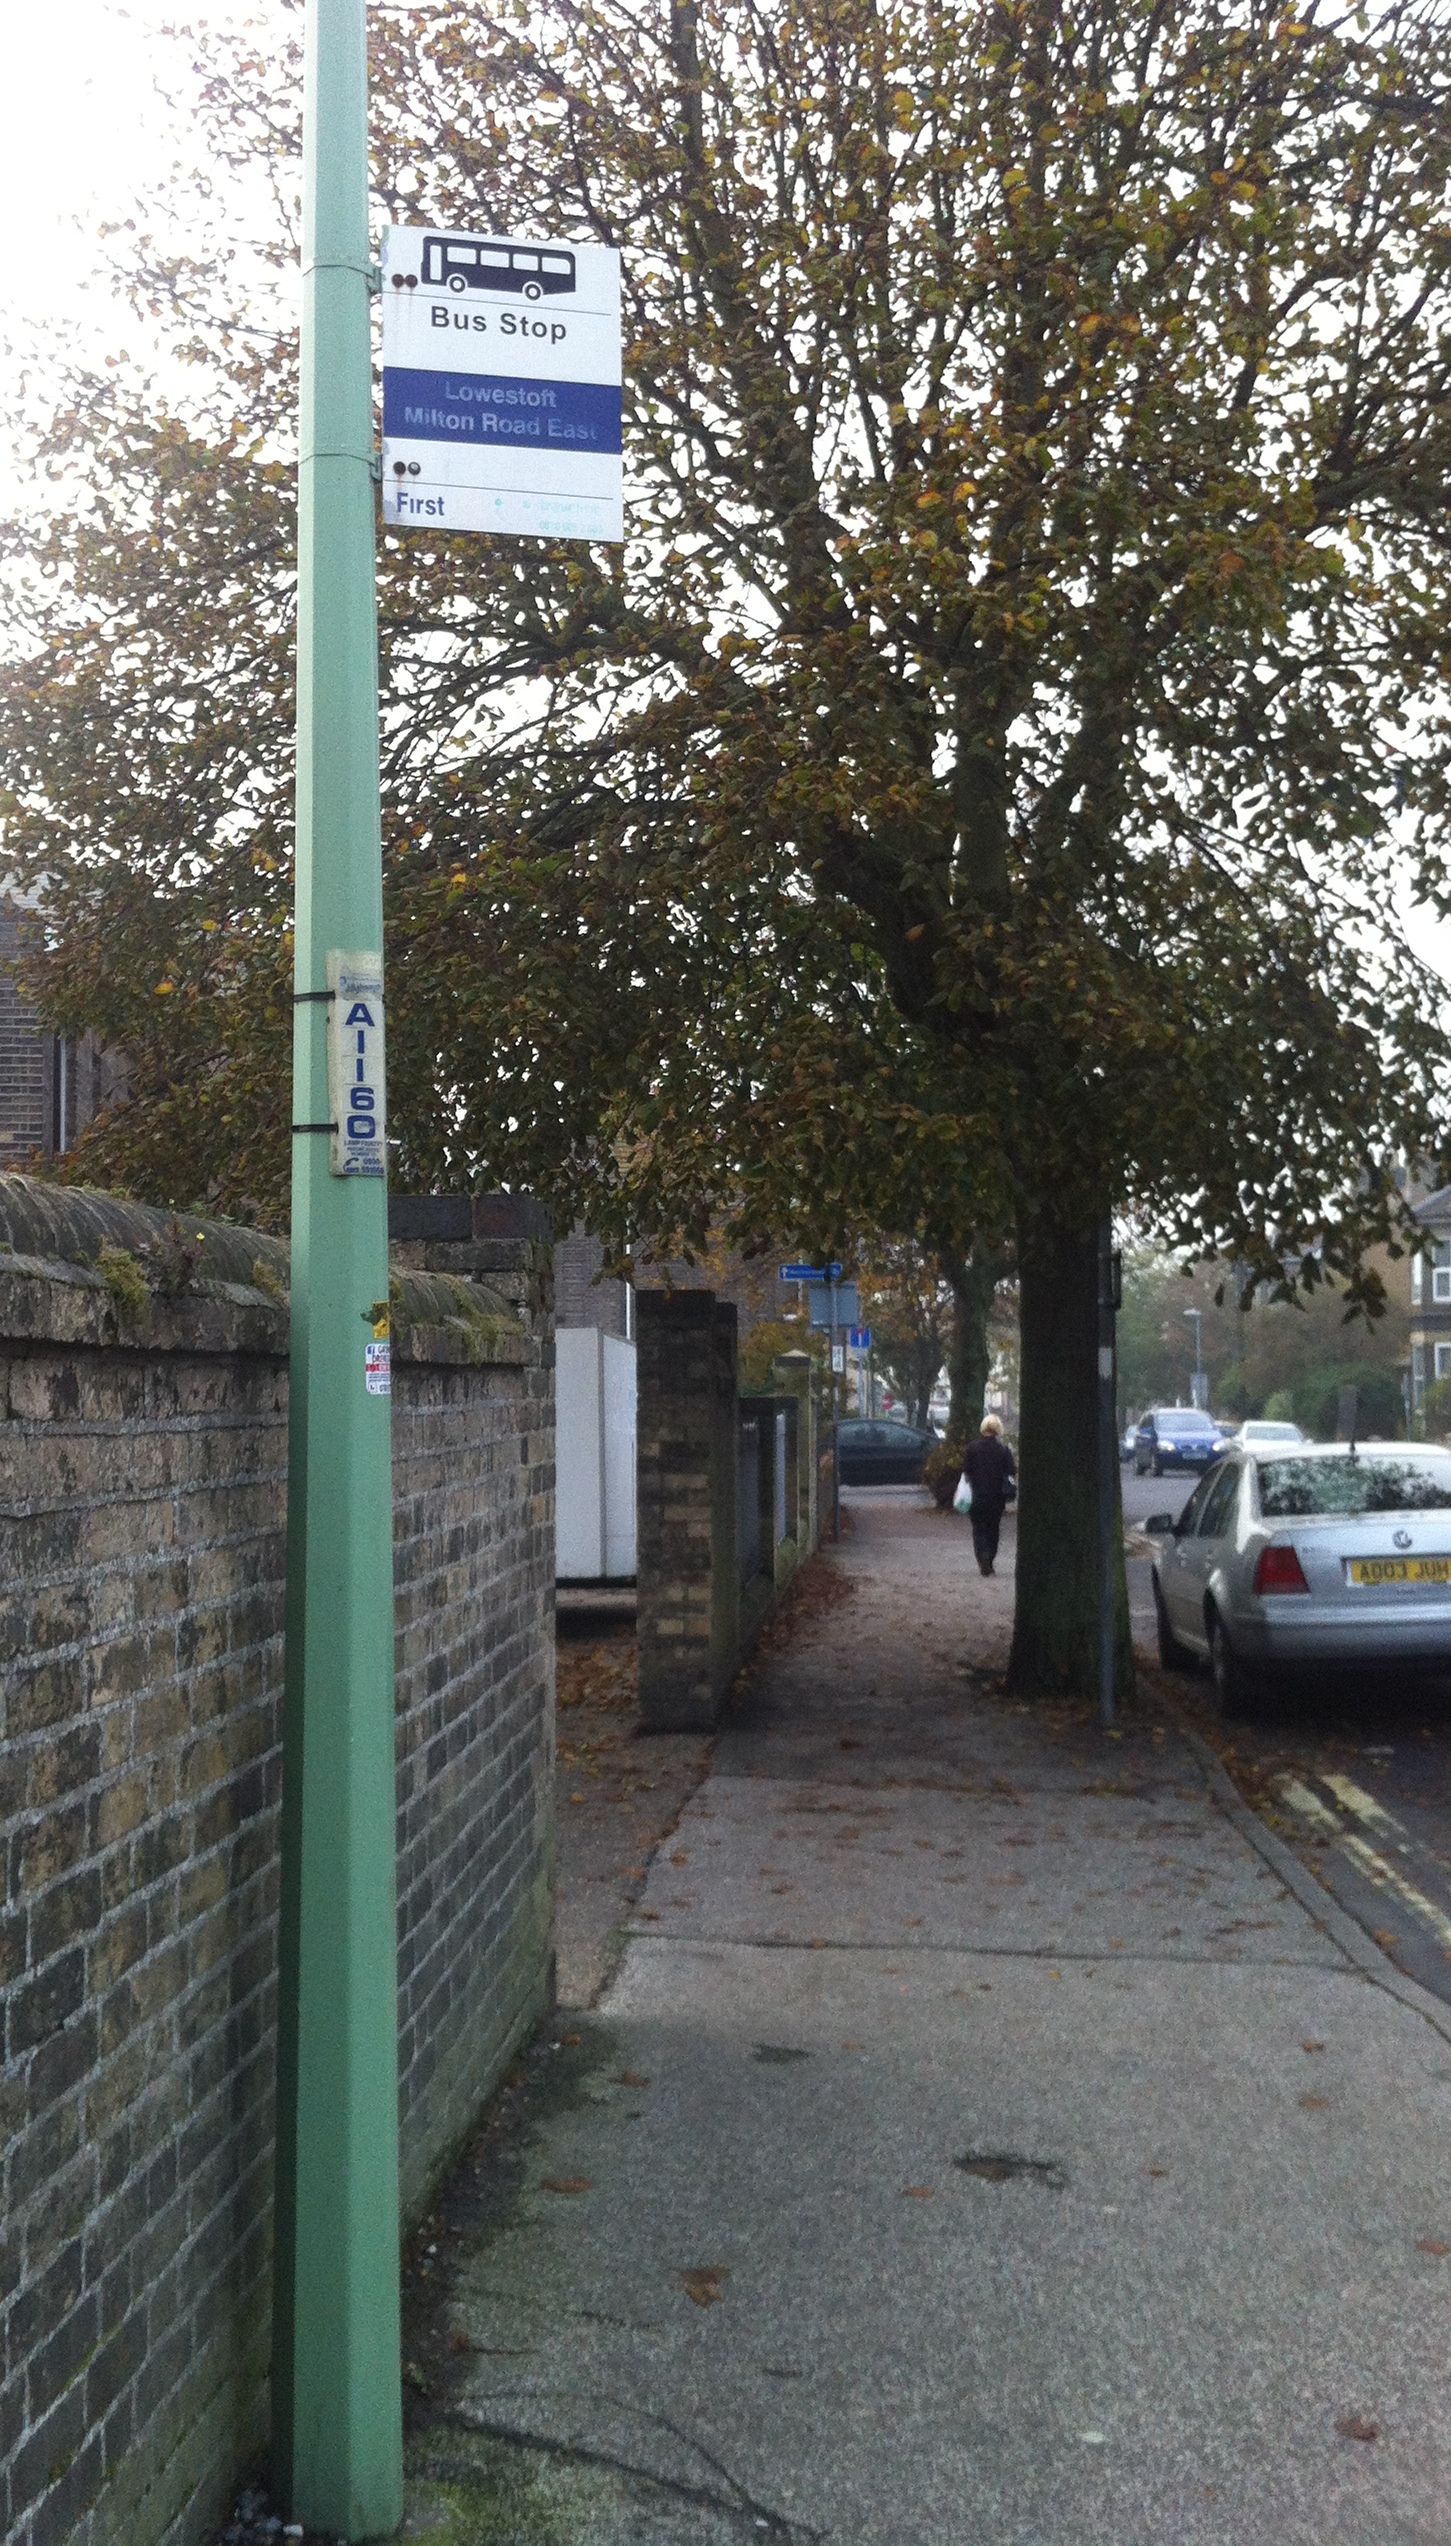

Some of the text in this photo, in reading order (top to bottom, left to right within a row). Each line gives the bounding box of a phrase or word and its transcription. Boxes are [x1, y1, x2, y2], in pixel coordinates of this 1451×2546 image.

[431, 305, 567, 345] Bus Stop
[446, 382, 557, 408] Lowestoft
[404, 406, 599, 440] Milton Road East
[396, 491, 445, 516] First
